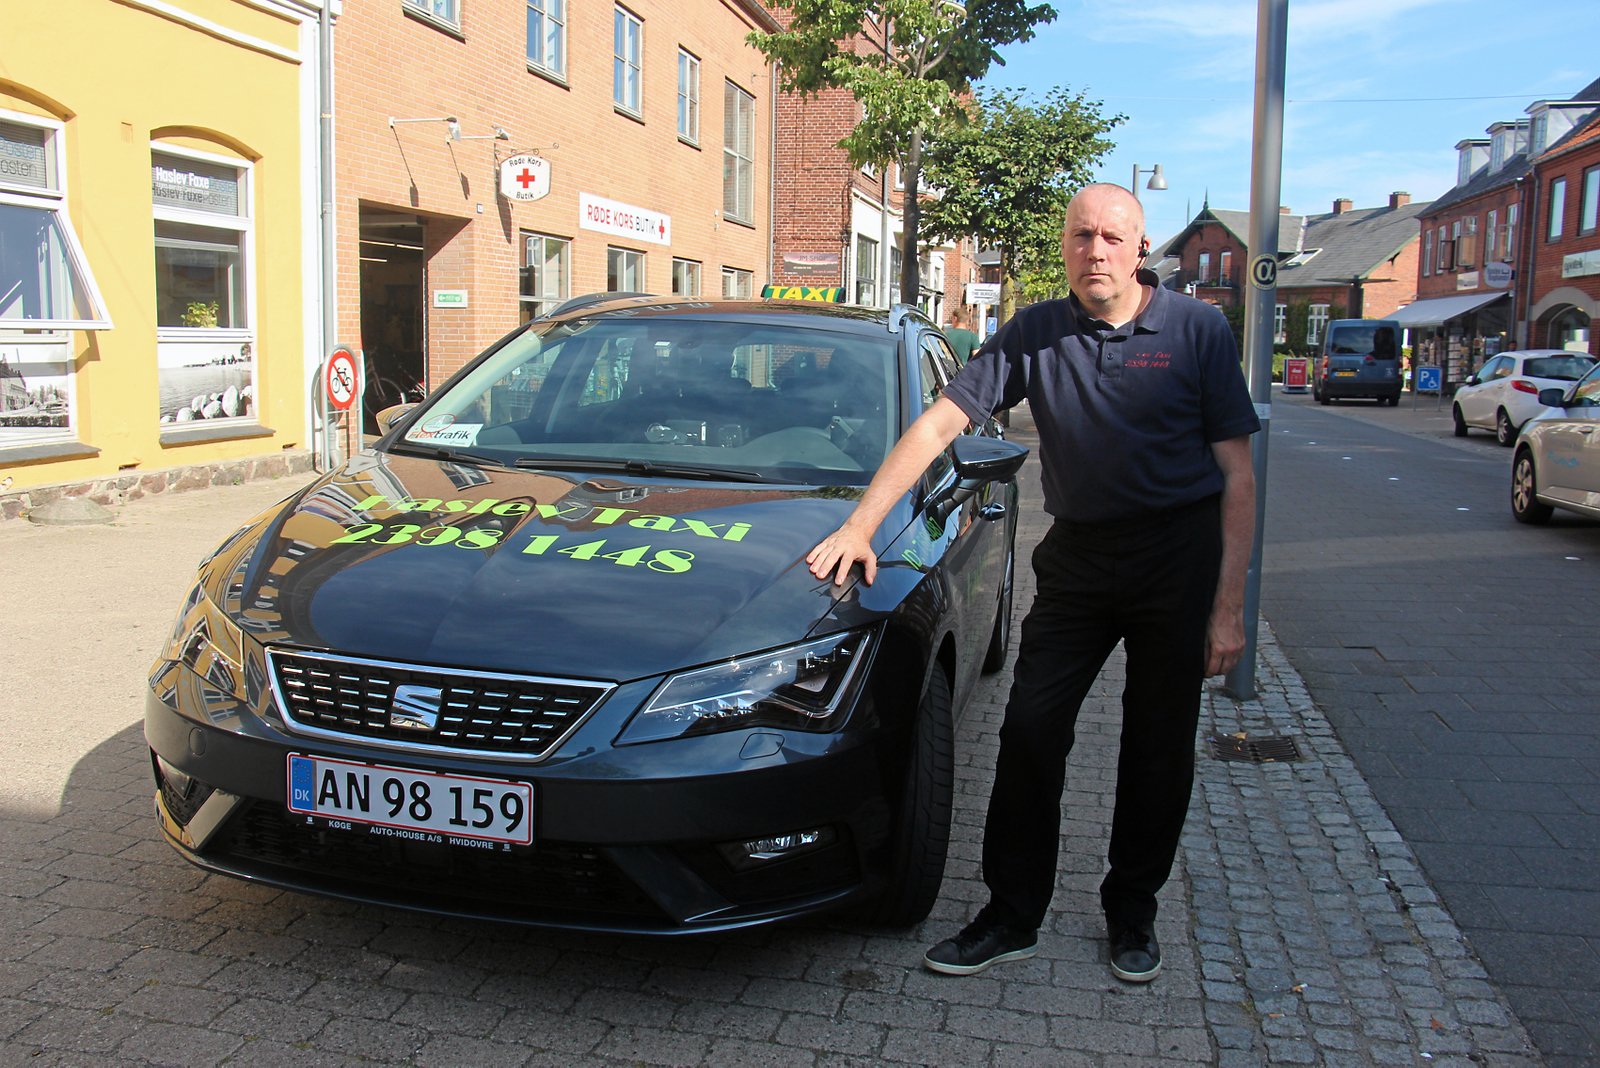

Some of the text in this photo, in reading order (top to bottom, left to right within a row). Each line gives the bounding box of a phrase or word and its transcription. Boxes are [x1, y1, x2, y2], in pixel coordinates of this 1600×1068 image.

[528, 157, 542, 167] Kors
[155, 166, 187, 185] Haslev
[189, 172, 209, 189] Faxe
[516, 192, 534, 200] Butik
[588, 204, 655, 235] RØDE KORS BUTIK
[768, 286, 837, 303] TAXI
[592, 507, 753, 542] Taxi
[329, 524, 696, 574] 2398 1448
[294, 788, 310, 802] DK
[317, 768, 524, 833] AN 98 159
[328, 819, 494, 849] KØGE AUTO-HOUSE A/S HVIDOVRE
